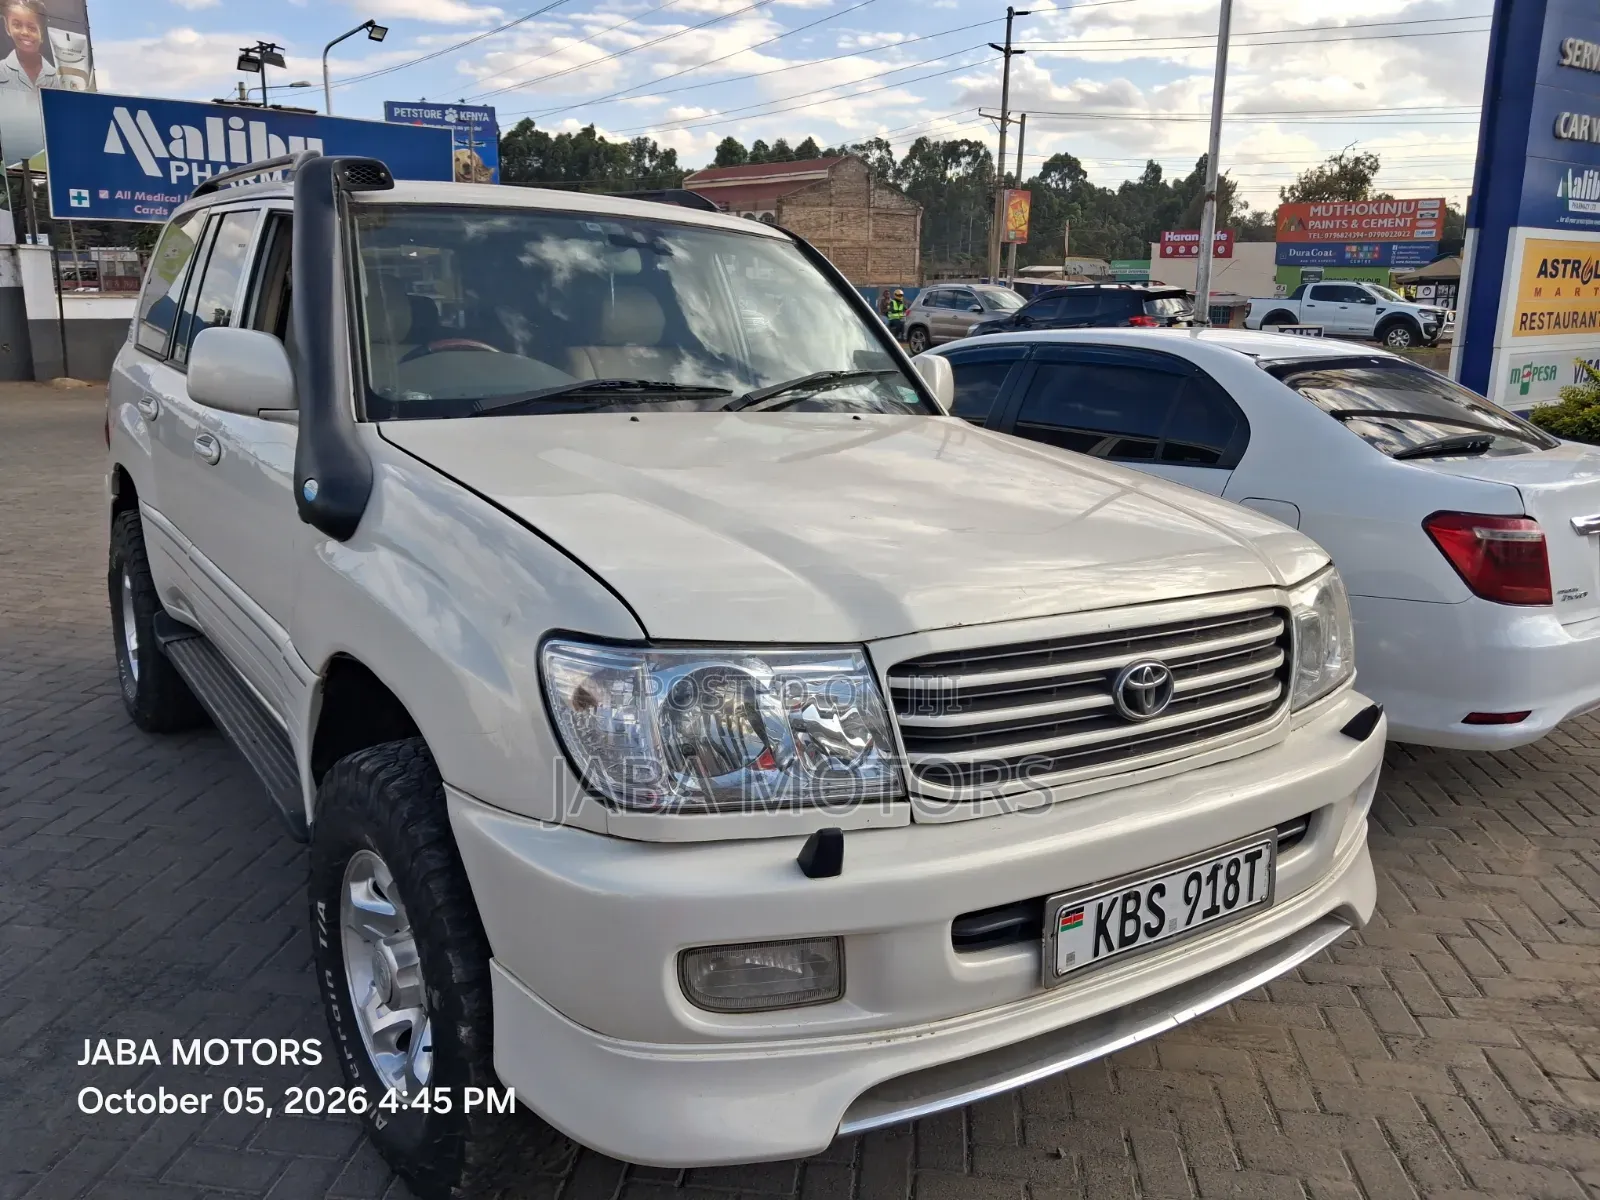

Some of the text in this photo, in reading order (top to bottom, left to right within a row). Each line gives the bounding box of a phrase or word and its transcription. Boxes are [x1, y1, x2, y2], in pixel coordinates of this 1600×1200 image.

[394, 107, 490, 122] PETSTORE KENYA
[115, 190, 132, 200] All
[134, 191, 181, 203] Medical
[134, 204, 168, 216] Cards
[1310, 202, 1415, 217] MUTHOKINJU
[1309, 220, 1348, 229] PAINTS
[1351, 219, 1358, 228] &
[1361, 217, 1413, 228] CEMENT
[1093, 849, 1262, 958] KBS 918T
[317, 901, 329, 948] T/A
